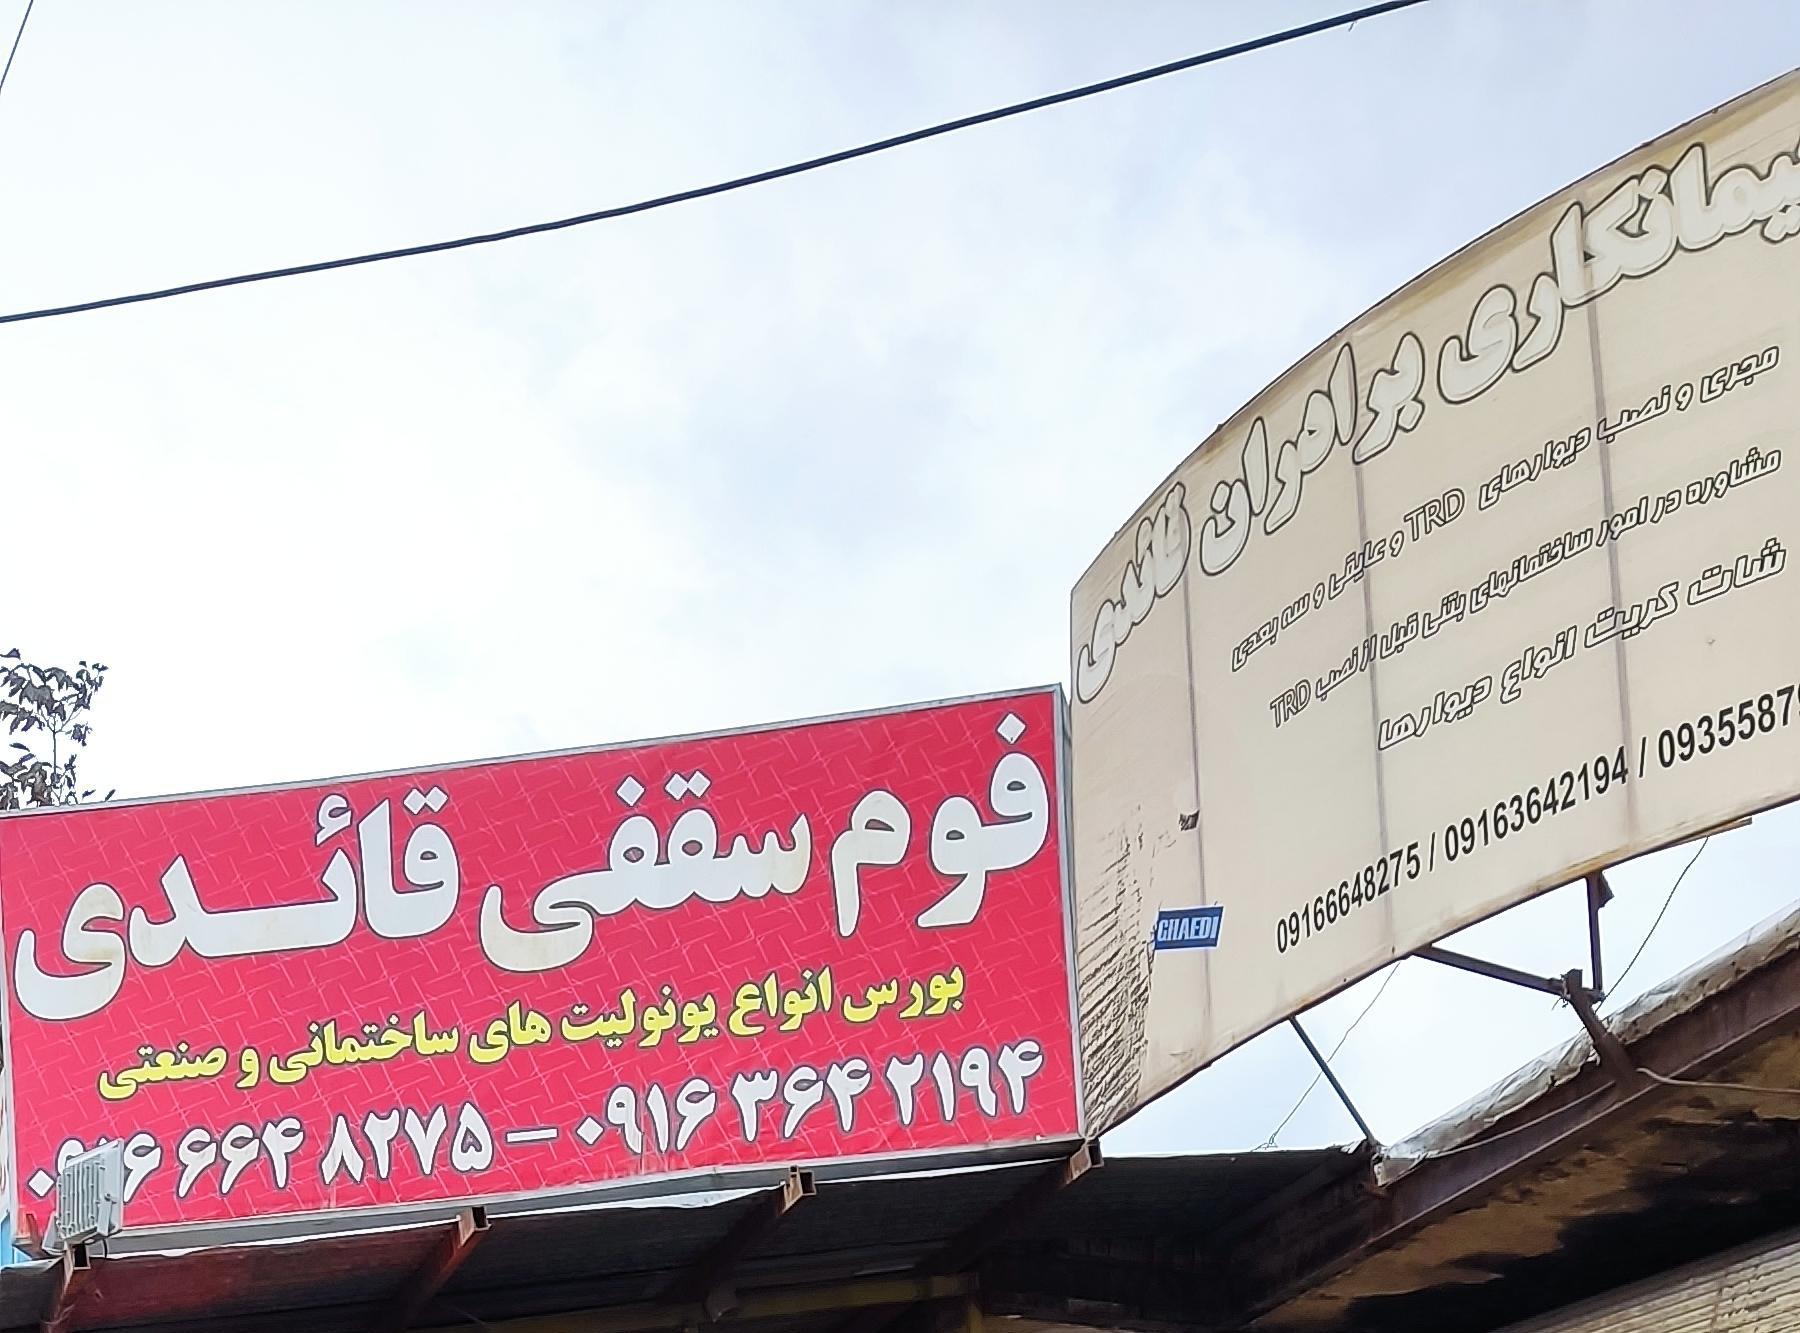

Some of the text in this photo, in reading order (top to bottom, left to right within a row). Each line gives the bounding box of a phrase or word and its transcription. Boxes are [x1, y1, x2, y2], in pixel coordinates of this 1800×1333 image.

[1438, 135, 1800, 405] یمانکاری
[1200, 331, 1425, 577] برادران
[1231, 345, 1779, 672] مجری و نصب دیوارهای TRD و عایقی و سه بعدی
[1270, 446, 1781, 728] مشاوره در امور ساختمانهای بتنی قبل از نصب TRD
[1376, 536, 1787, 750] شات کریت انواع دیوارها
[11, 712, 1051, 1023] فوم سقفی قائدی
[1157, 915, 1220, 942] GHAEDI
[1276, 683, 1800, 953] 09166648275 / 09163642194 / 0935587
[98, 964, 966, 1100] بورس انواع یونولیت های ساختمانی و صنعتی
[177, 1116, 305, 1199] ۶۶۴
[320, 1101, 495, 1185] ۸۲۷۵
[575, 1078, 717, 1156] ۰۹۱۶
[731, 1057, 872, 1144] ۳۶۴
[885, 1039, 1045, 1126] ۲۱۹۴
